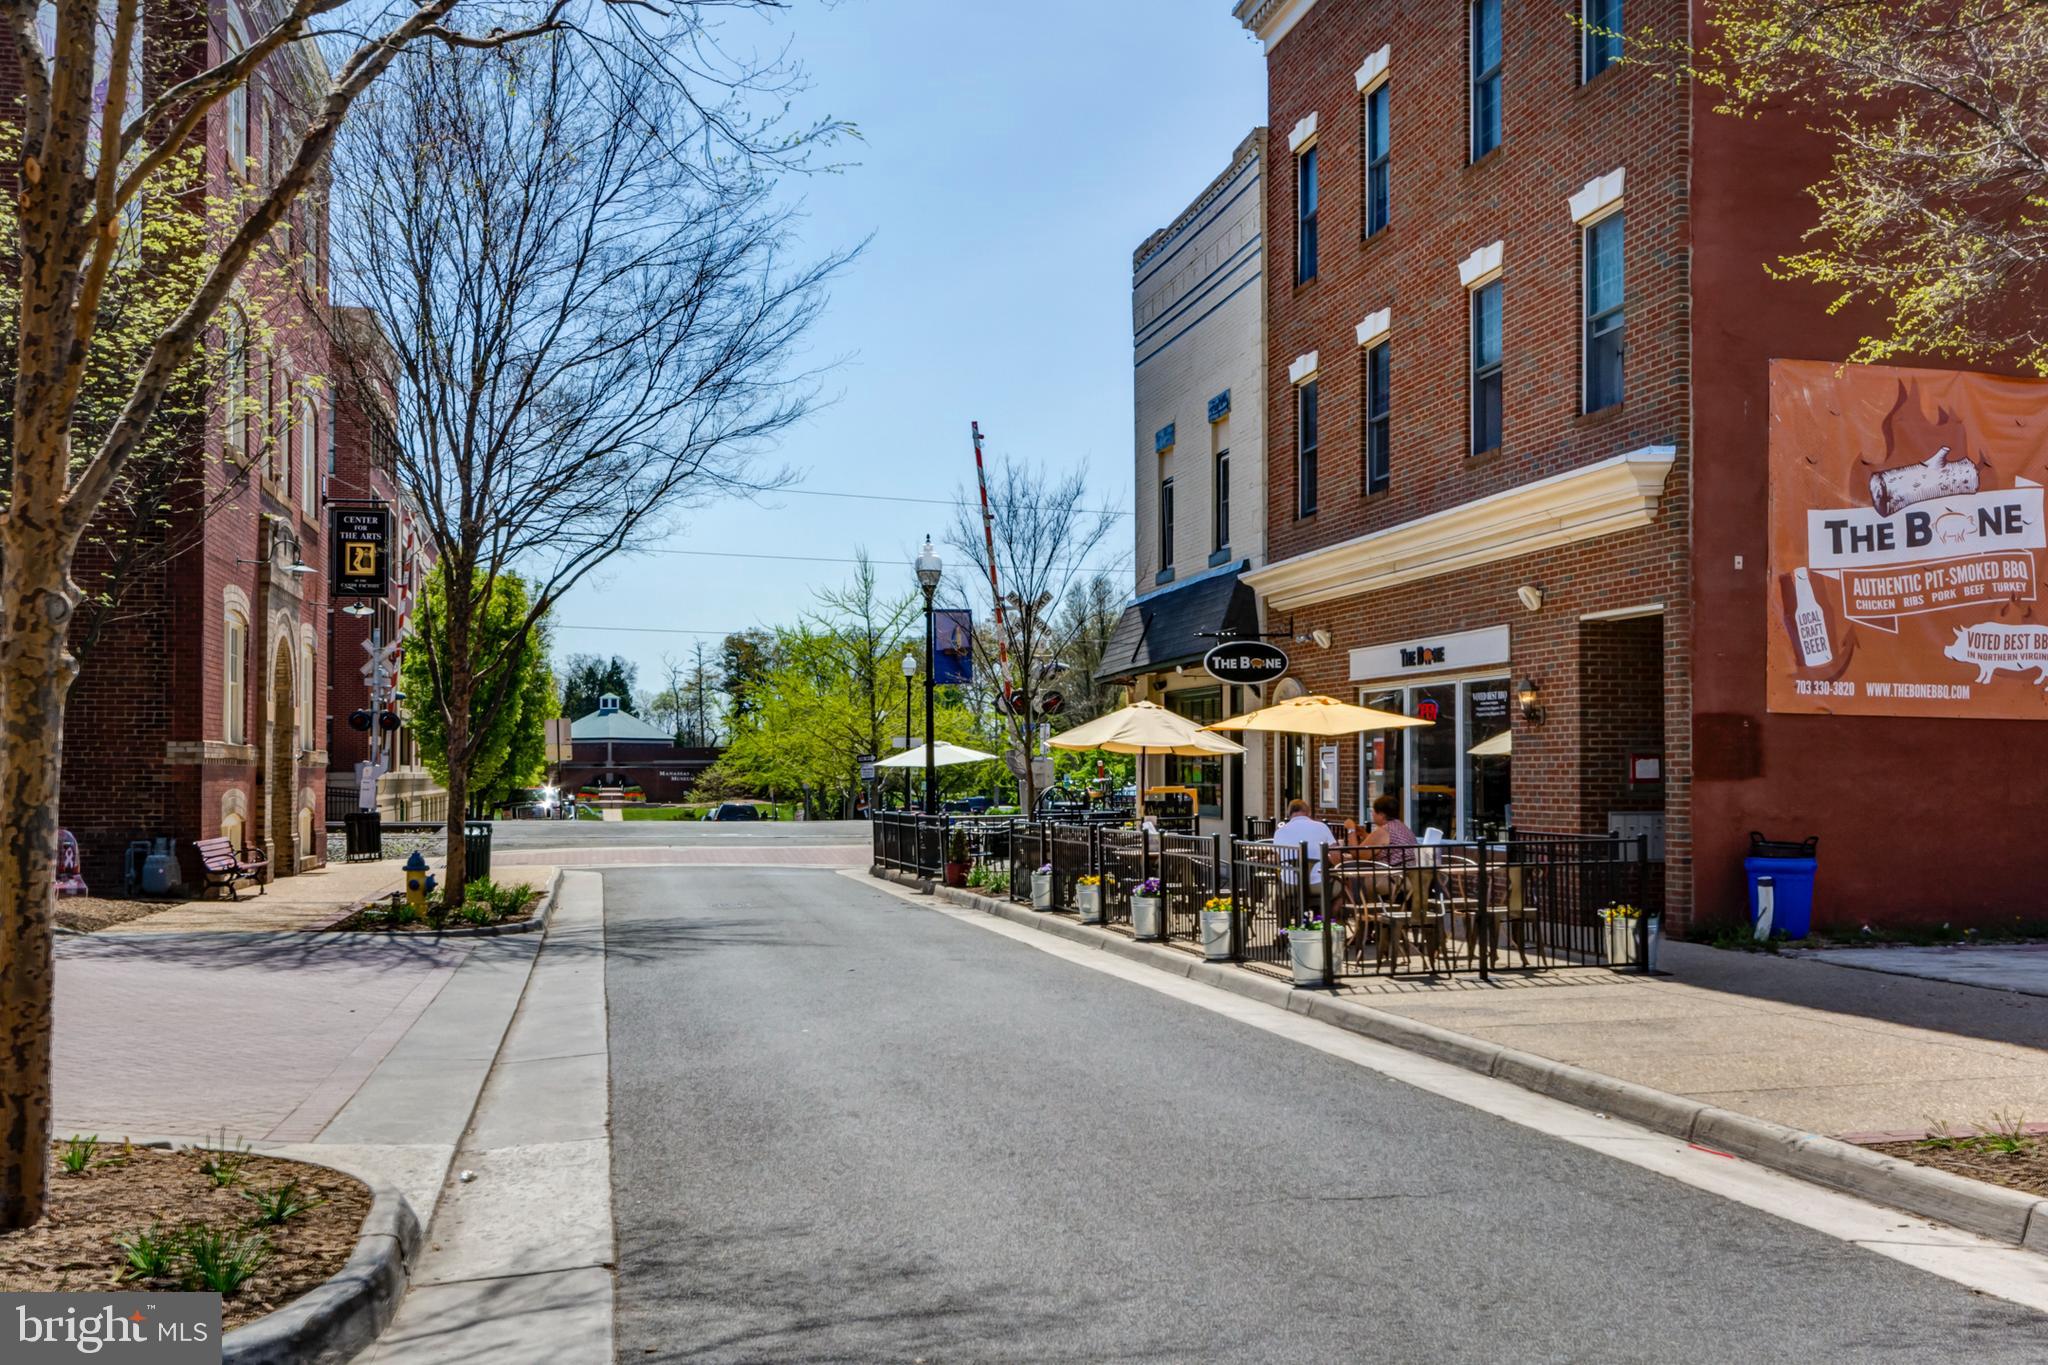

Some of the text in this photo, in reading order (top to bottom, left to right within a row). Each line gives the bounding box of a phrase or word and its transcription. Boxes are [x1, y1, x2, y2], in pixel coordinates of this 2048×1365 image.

[343, 516, 378, 525] CENTER
[340, 532, 382, 540] THE ARTS
[1824, 519, 1895, 554] THE
[1853, 560, 2029, 597] AUTHENTIC PIT-SMOKED BBQ
[1855, 582, 2027, 611] CHICKEN RIBS PORK BEEF TURKEY
[1798, 610, 1822, 626] LOCAL
[1800, 623, 1824, 639] CRAFT
[1803, 636, 1828, 656] BEER
[1967, 631, 2048, 651] VOTED BEST BB
[1212, 656, 1238, 669] THE
[1967, 650, 2048, 661] IN NORTHERN VIRGIN
[1795, 680, 1971, 699] 703 330-3820 WWW.THEBONEBBQ.COM
